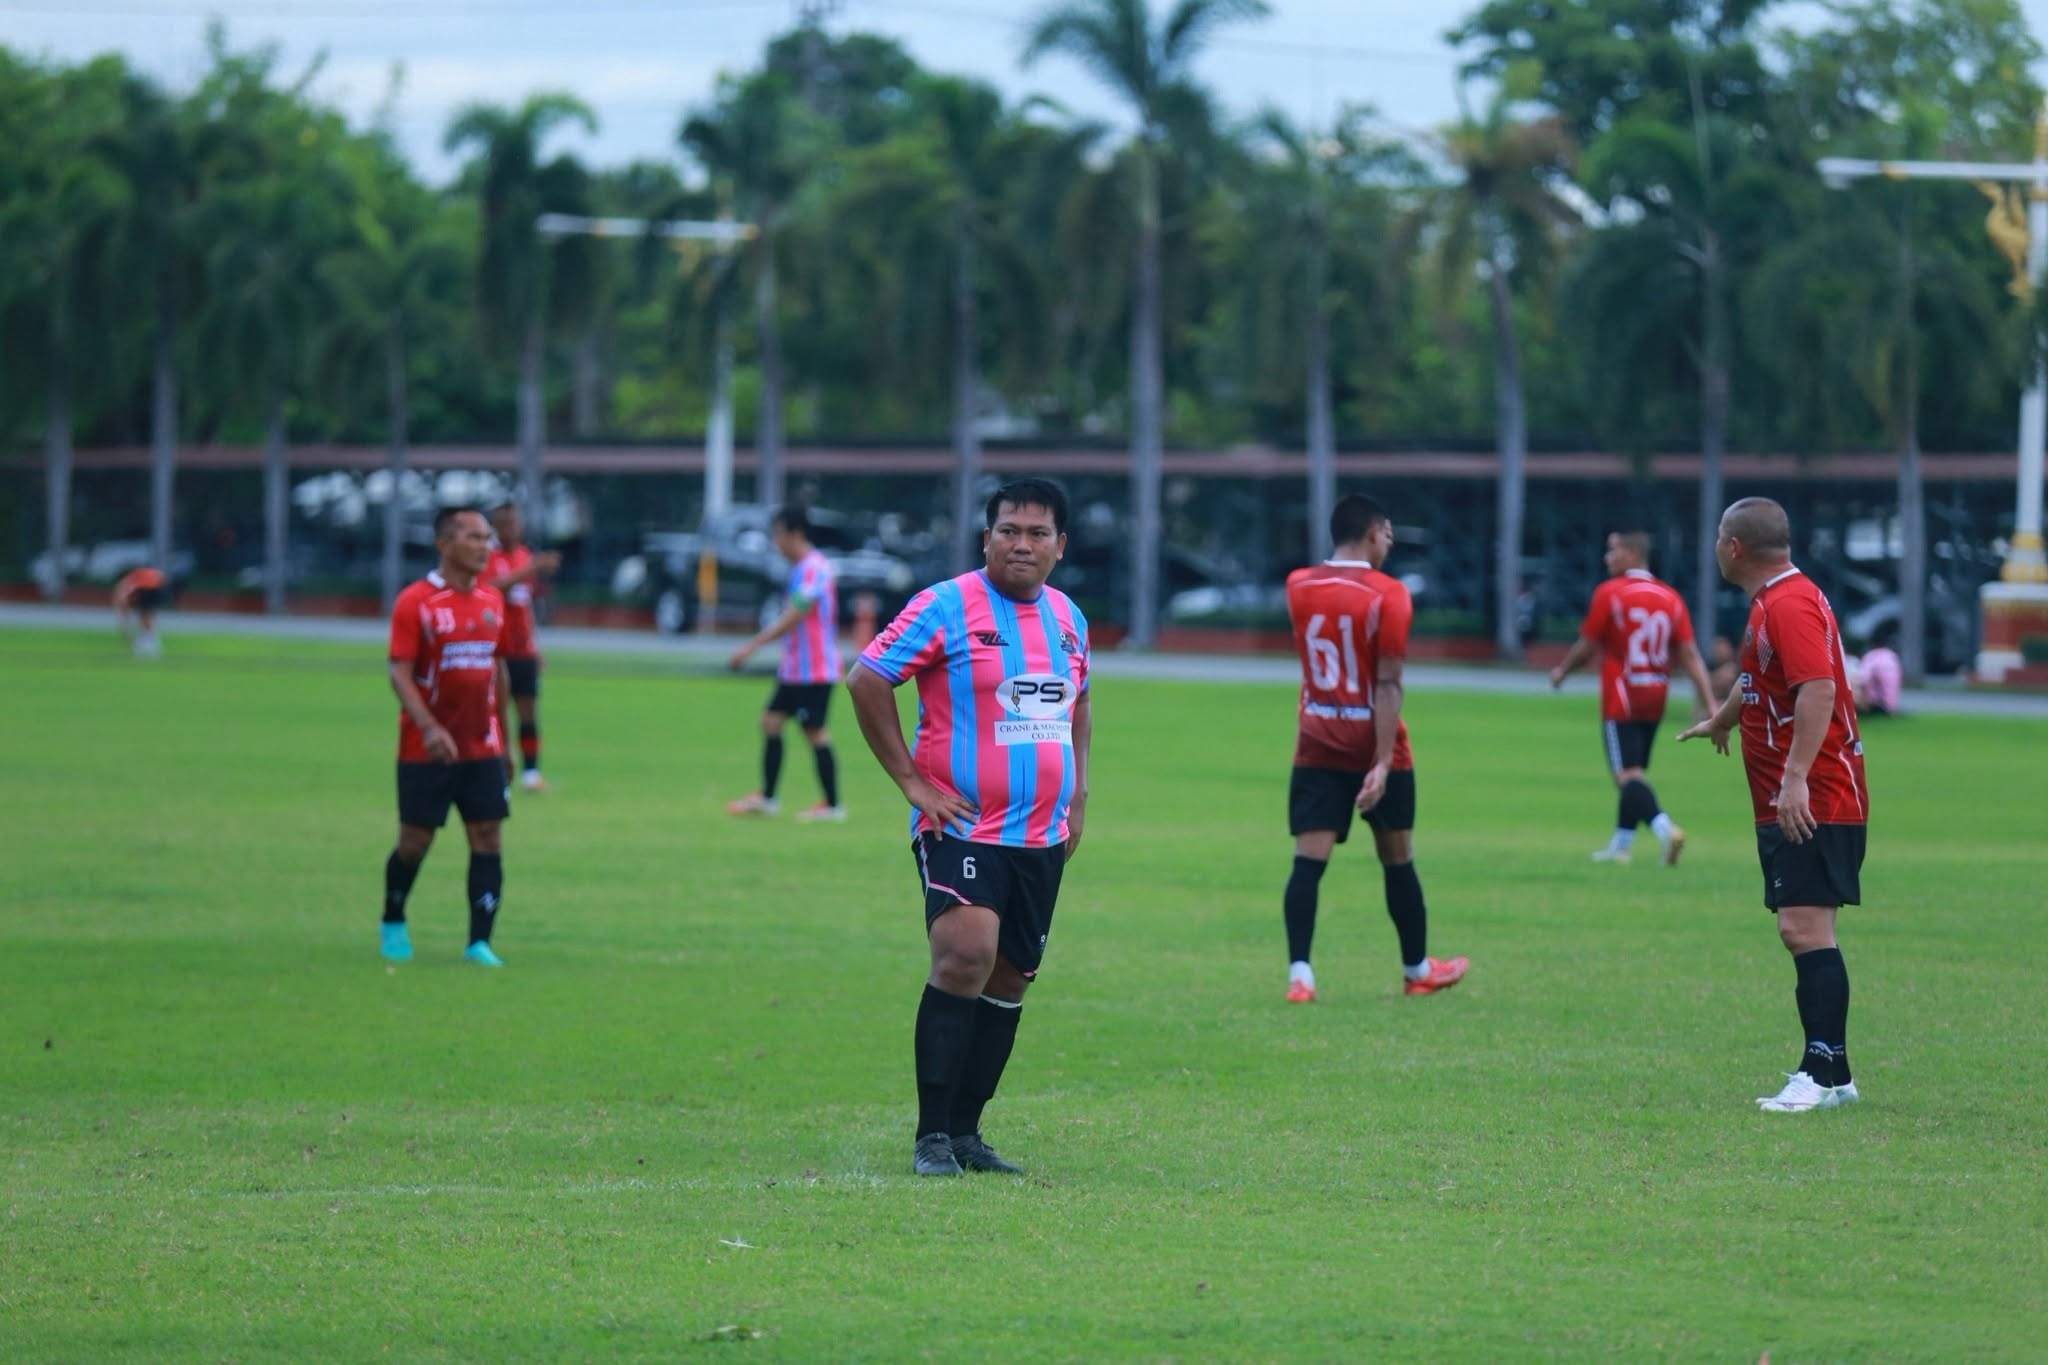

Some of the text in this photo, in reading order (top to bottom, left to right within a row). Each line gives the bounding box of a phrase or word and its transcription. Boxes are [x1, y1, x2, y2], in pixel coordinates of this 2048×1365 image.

[1628, 607, 1671, 667] 20
[1305, 613, 1360, 692] 61
[1013, 680, 1064, 703] PS
[999, 723, 1030, 733] CRANE
[962, 856, 976, 879] 6
